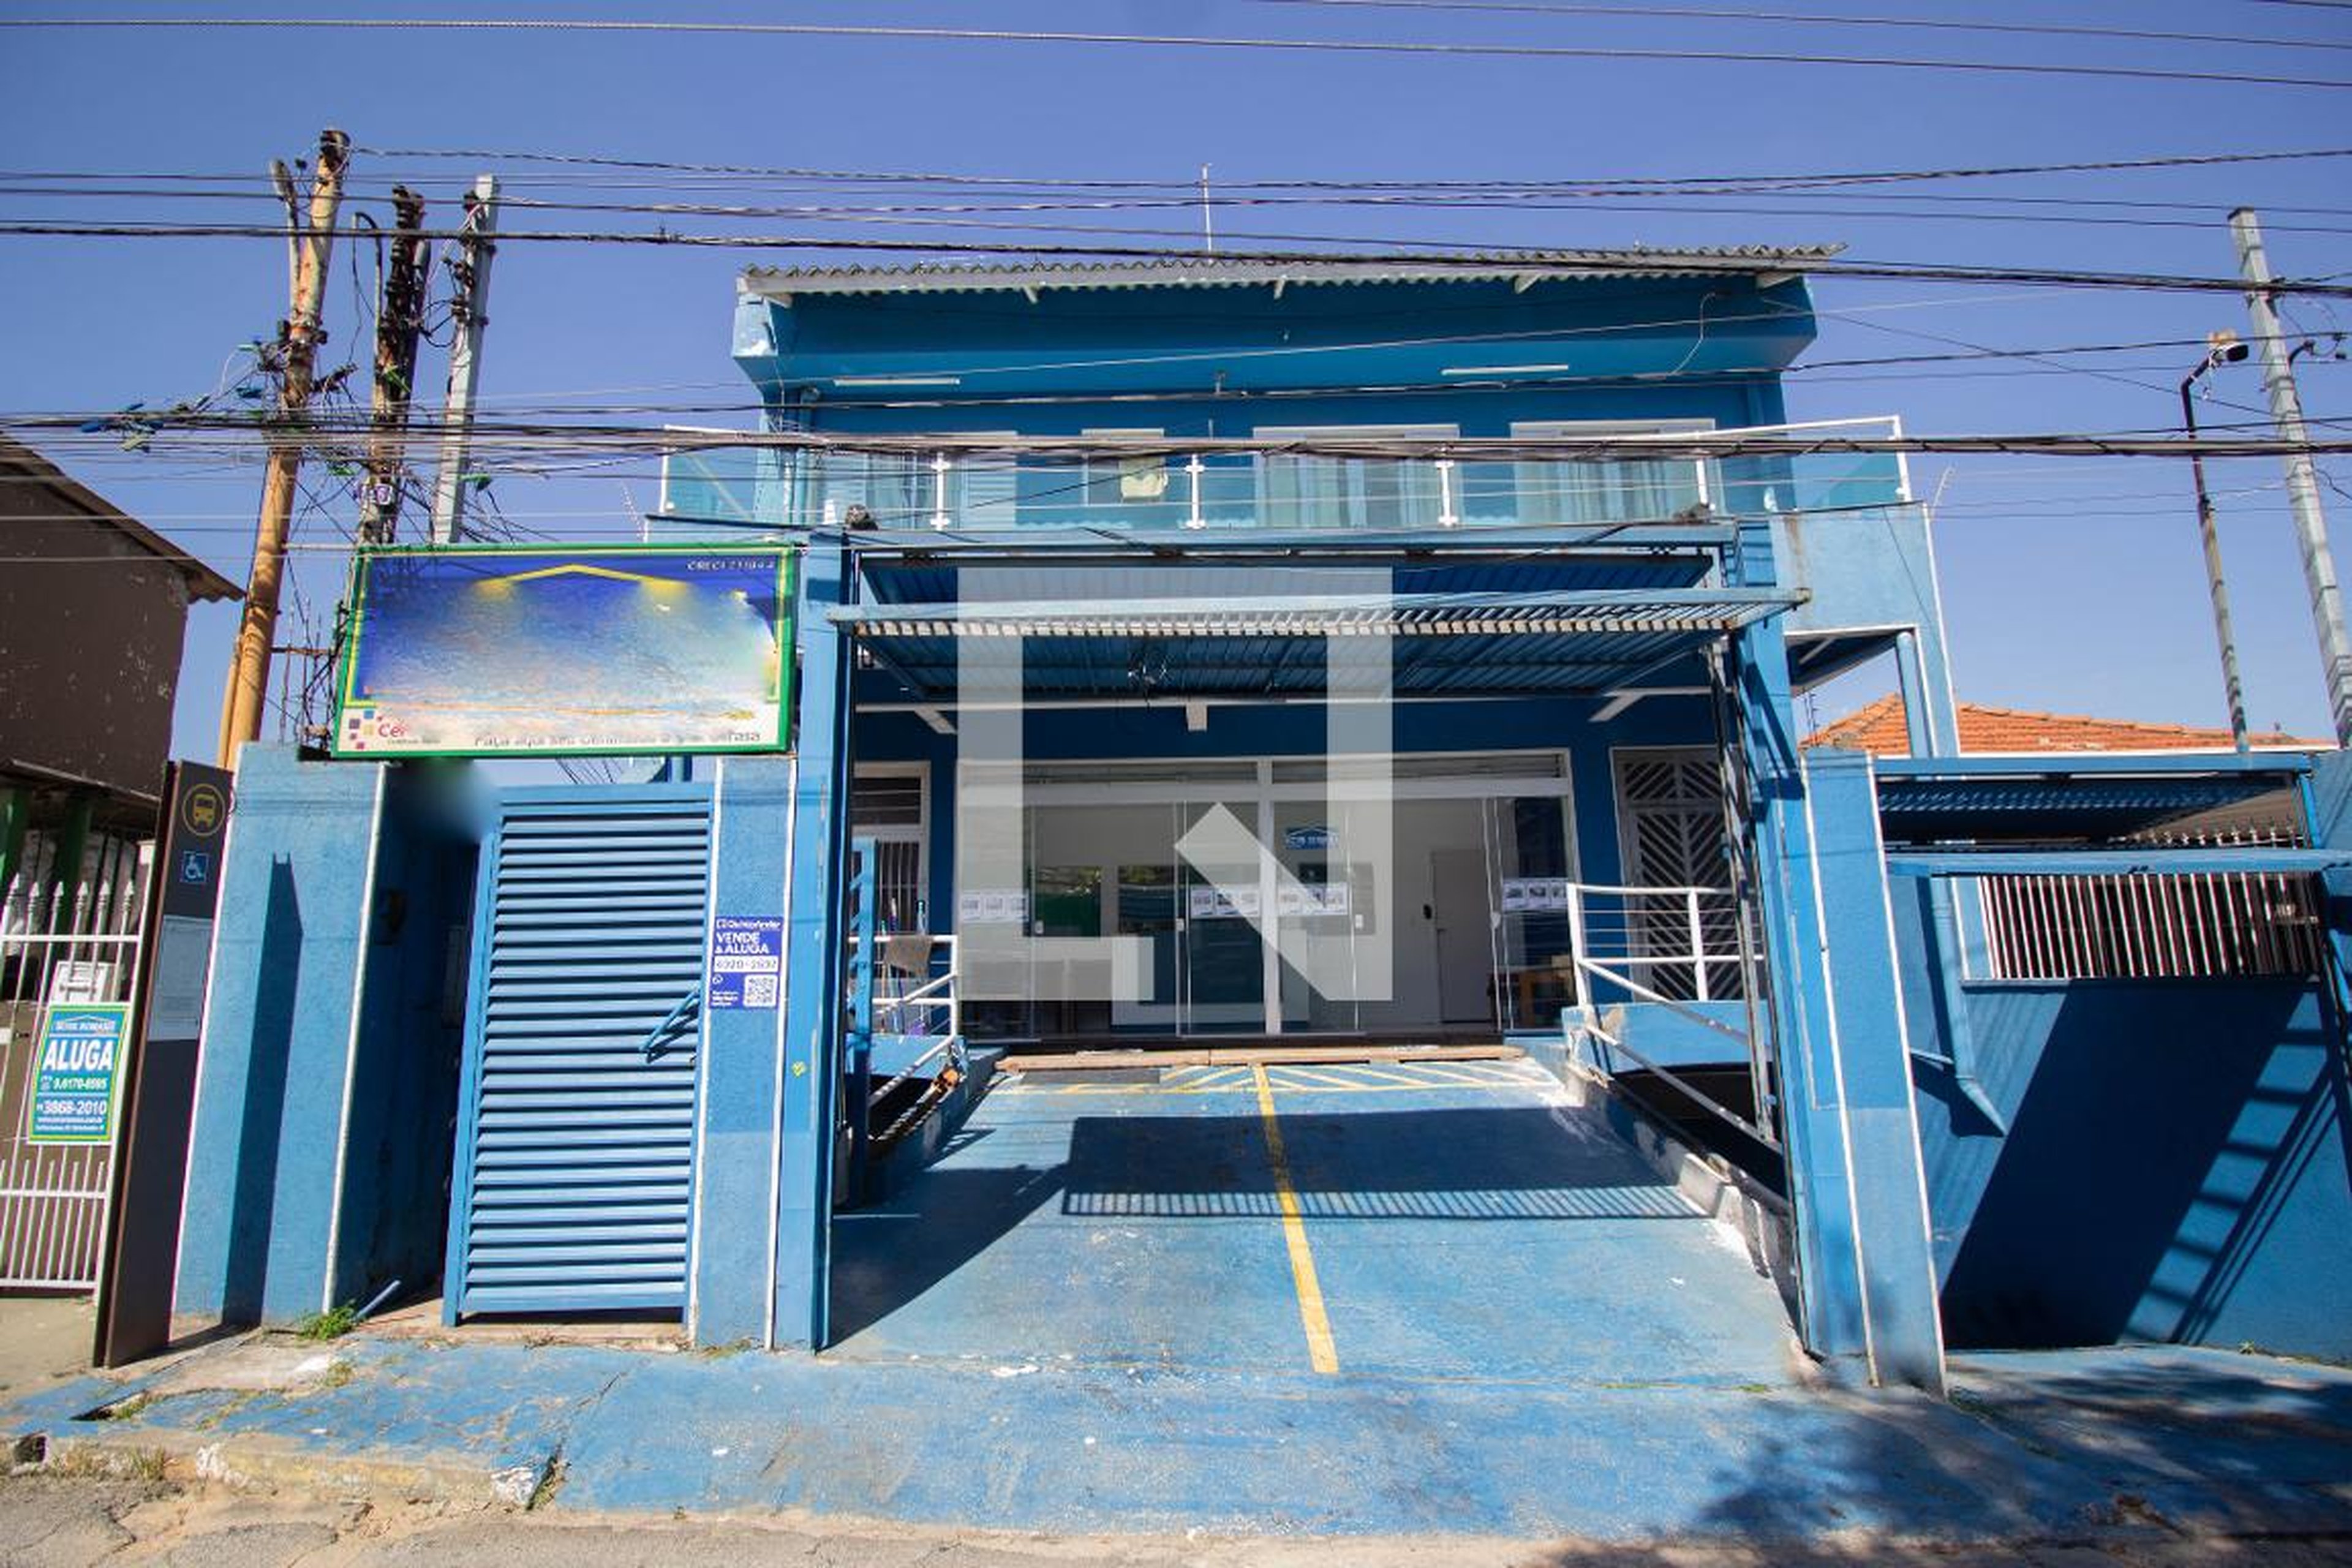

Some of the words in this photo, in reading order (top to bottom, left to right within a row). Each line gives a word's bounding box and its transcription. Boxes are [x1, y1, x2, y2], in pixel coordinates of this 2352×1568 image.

[715, 932, 760, 944] VENDE
[724, 943, 770, 954] ALUGA
[42, 1039, 114, 1071] ALUGA
